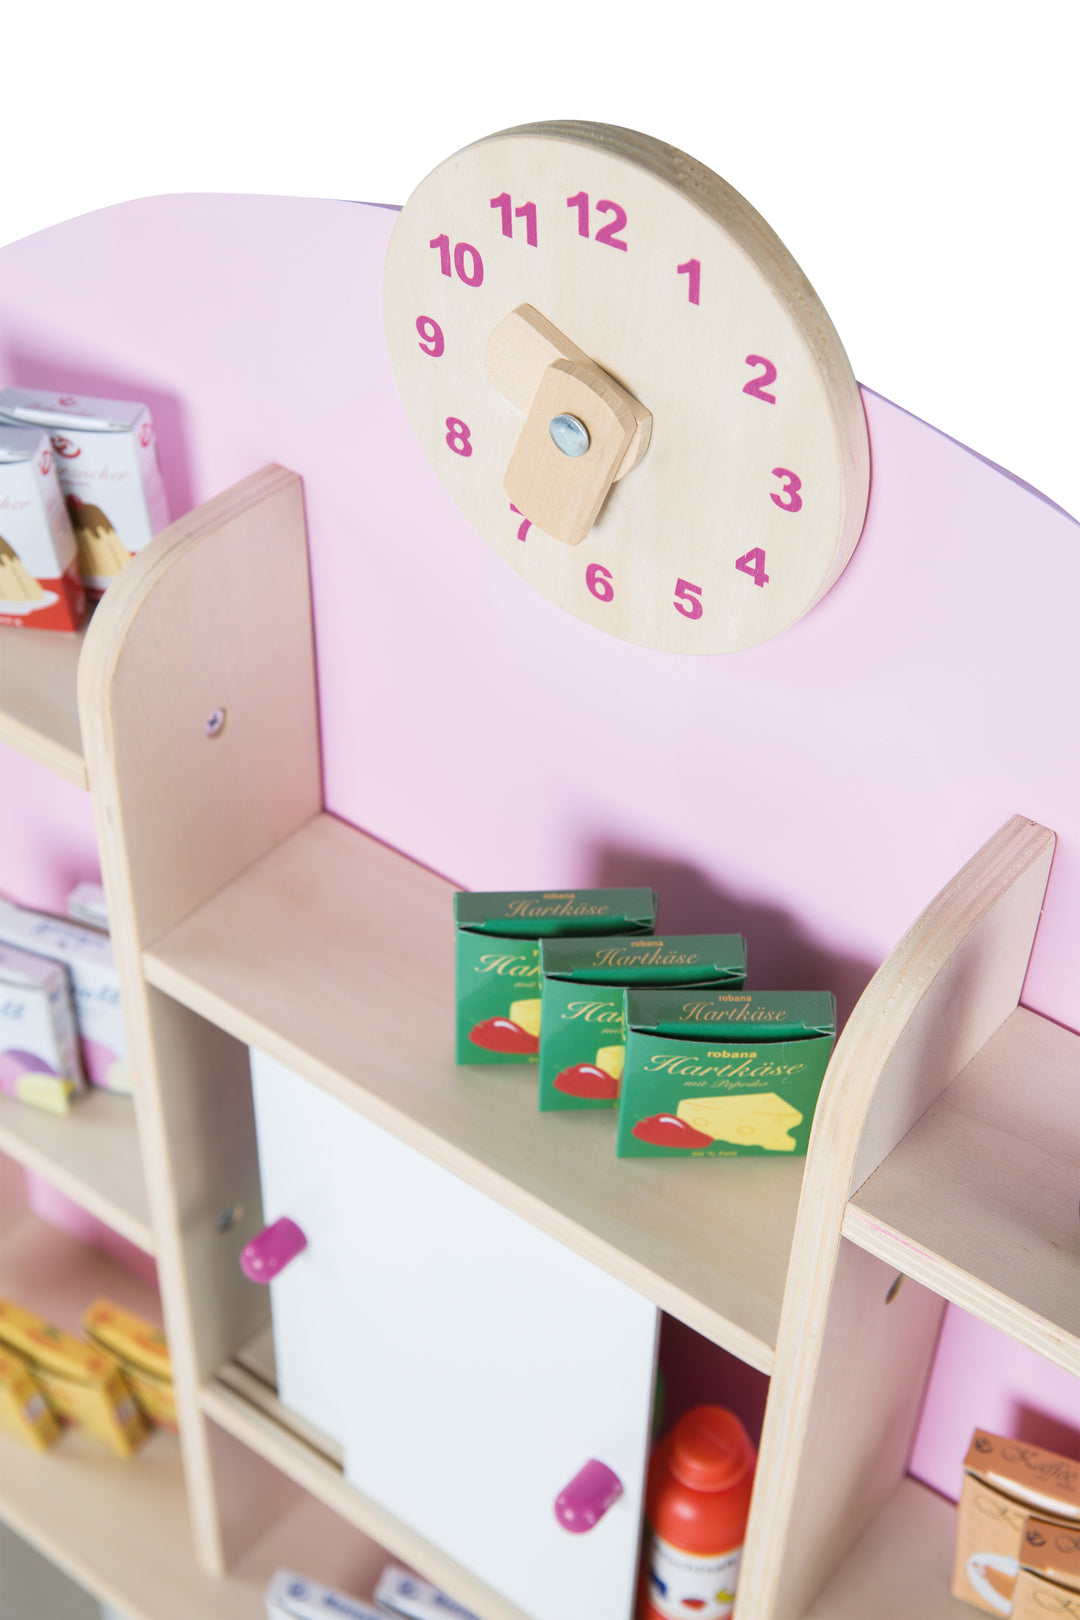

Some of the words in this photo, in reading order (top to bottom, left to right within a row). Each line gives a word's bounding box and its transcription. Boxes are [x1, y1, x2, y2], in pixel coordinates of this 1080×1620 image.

[490, 192, 538, 248] 11
[566, 191, 628, 253] 12
[429, 233, 484, 288] 10
[676, 258, 701, 306] 1
[415, 315, 445, 358] 9
[742, 354, 778, 405] 2
[445, 416, 473, 458] 8
[769, 467, 803, 513] 3
[585, 562, 615, 603] 6
[735, 546, 770, 588] 4
[672, 577, 704, 621] 5
[504, 898, 609, 917] Hartkäse
[543, 892, 575, 900] robana
[592, 947, 701, 967] Hartkäse
[631, 940, 664, 948] robana
[679, 1001, 789, 1021] Hartkäse
[718, 994, 752, 1002] robana
[643, 1053, 808, 1078] Hartkäse
[707, 1050, 757, 1059] robana
